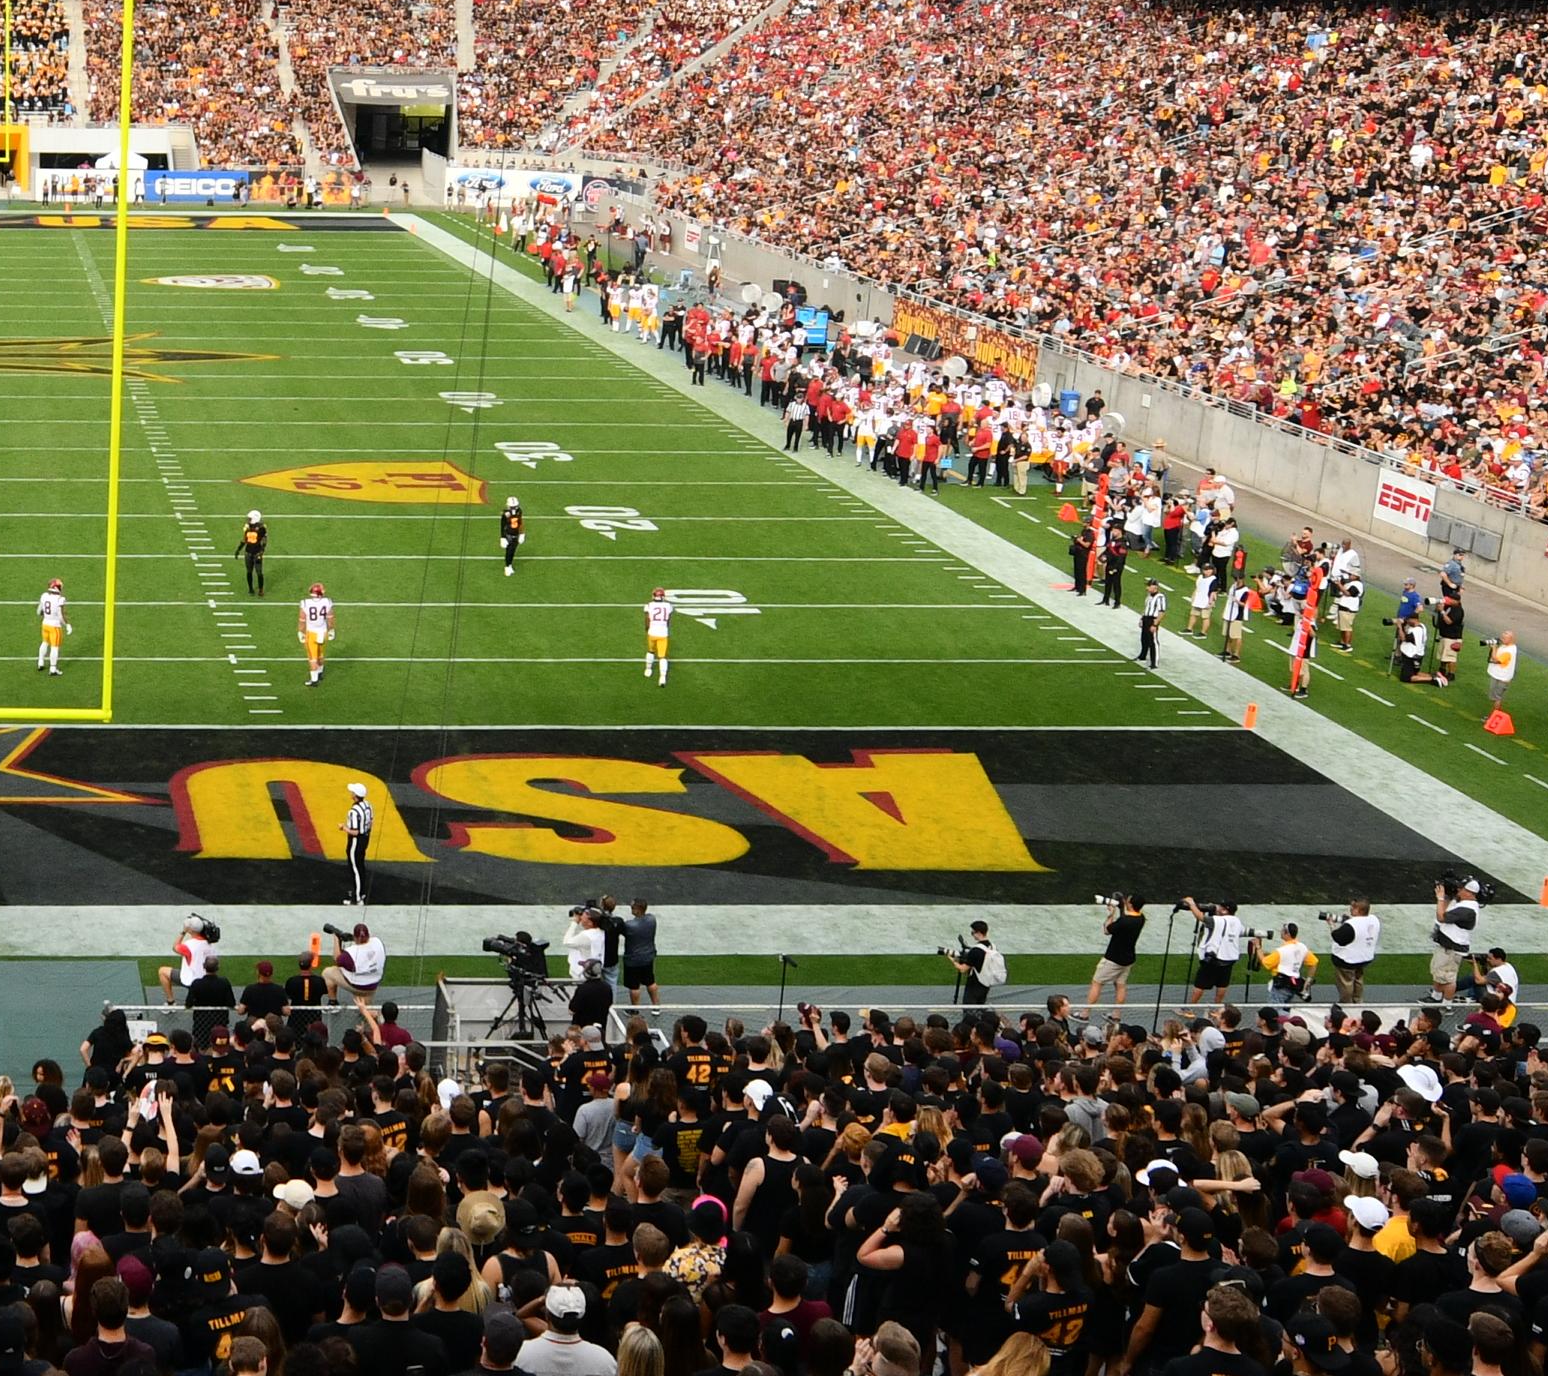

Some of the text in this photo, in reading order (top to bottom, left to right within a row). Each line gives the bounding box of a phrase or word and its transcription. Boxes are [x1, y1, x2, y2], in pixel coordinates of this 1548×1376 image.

[153, 178, 237, 196] GEICO
[538, 177, 564, 193] Ford
[36, 216, 300, 230] USA
[393, 350, 455, 366] 50
[1377, 482, 1433, 523] ESPN
[565, 506, 660, 536] 20
[44, 600, 52, 615] 8
[309, 606, 327, 621] 84
[665, 589, 763, 623] 10
[653, 607, 668, 622] 21
[584, 1060, 607, 1068] TILLMAN
[686, 1064, 710, 1084] 42
[1048, 1304, 1087, 1320] TILLMAN
[1043, 1317, 1085, 1346] 42
